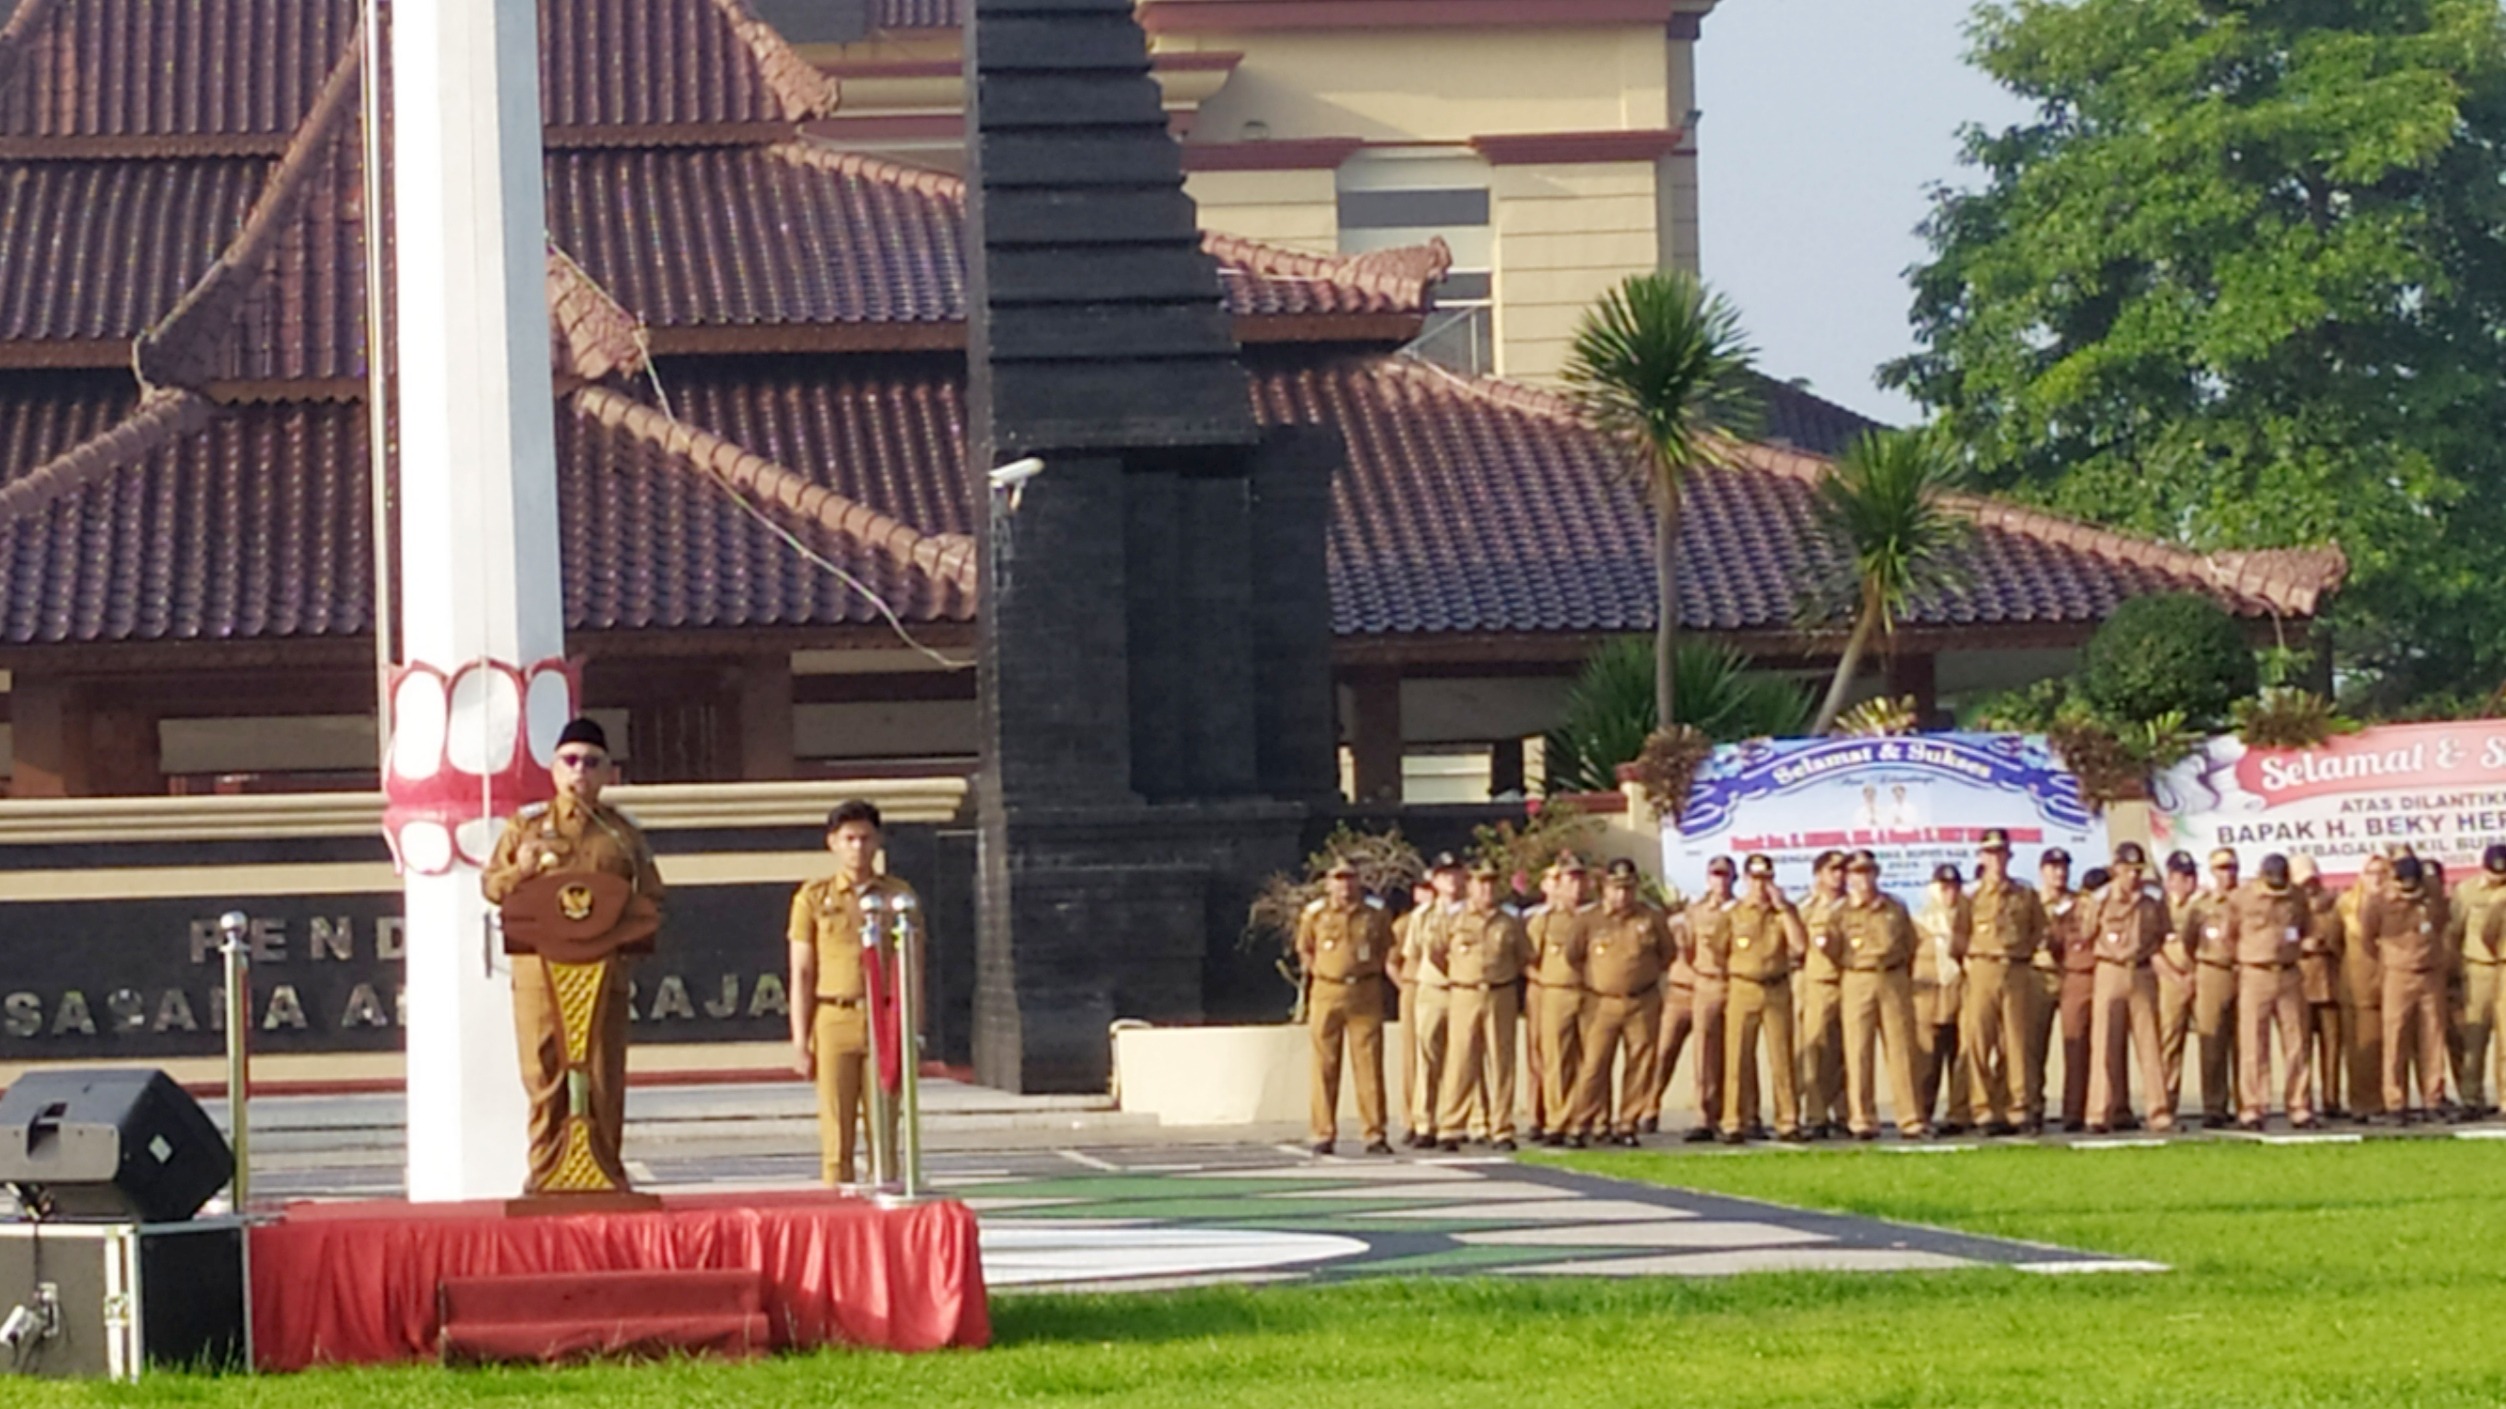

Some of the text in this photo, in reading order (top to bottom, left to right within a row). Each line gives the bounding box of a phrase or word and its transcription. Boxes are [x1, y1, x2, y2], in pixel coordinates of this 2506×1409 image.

[1771, 743, 1992, 785] Selamat & Sukses
[2260, 735, 2506, 791] Selamat & S
[2341, 796, 2393, 813] ATAS
[2217, 820, 2314, 845] BAPAK
[2326, 819, 2355, 838] H.
[2366, 813, 2444, 836] BEKY
